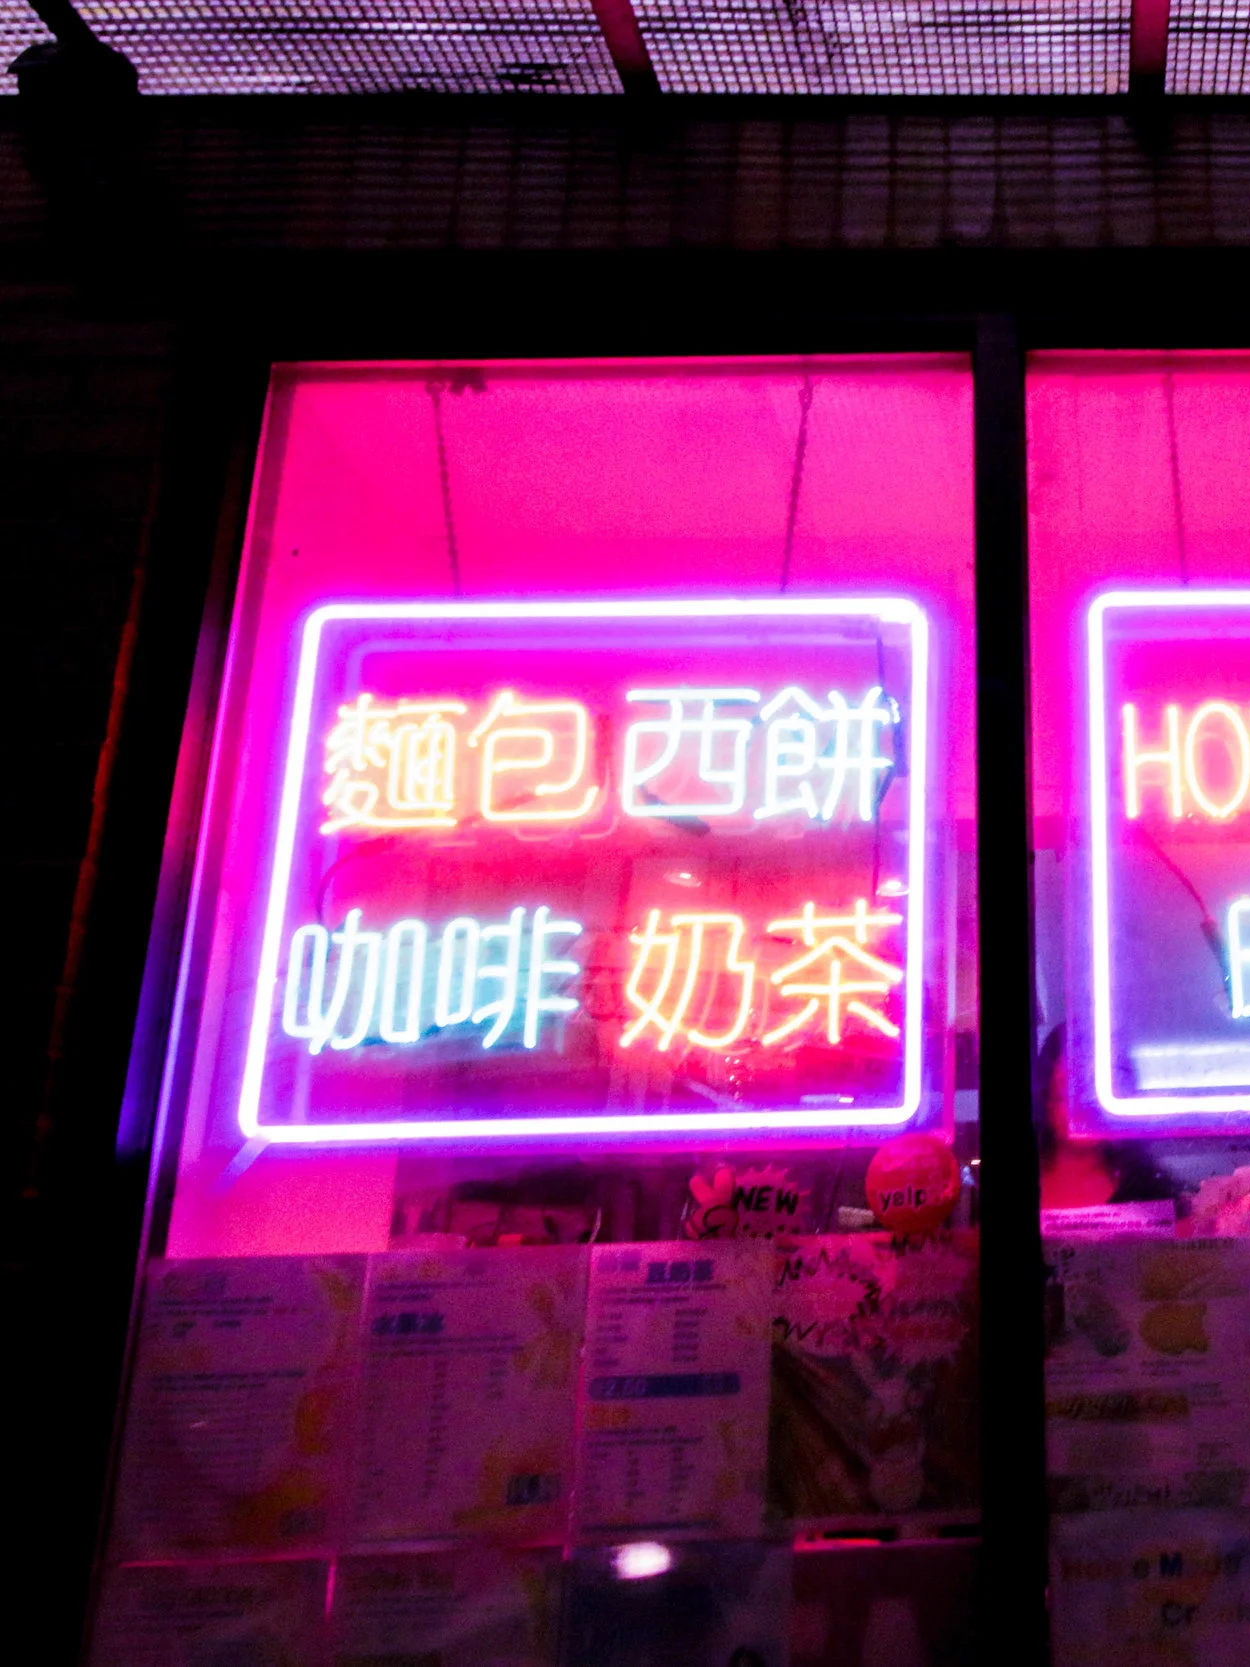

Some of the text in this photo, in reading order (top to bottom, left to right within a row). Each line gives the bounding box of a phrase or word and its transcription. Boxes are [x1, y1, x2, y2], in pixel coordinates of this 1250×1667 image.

[283, 899, 903, 1056] 咖啡 奶茶
[733, 1185, 799, 1215] NEW
[878, 1184, 928, 1213] yelp
